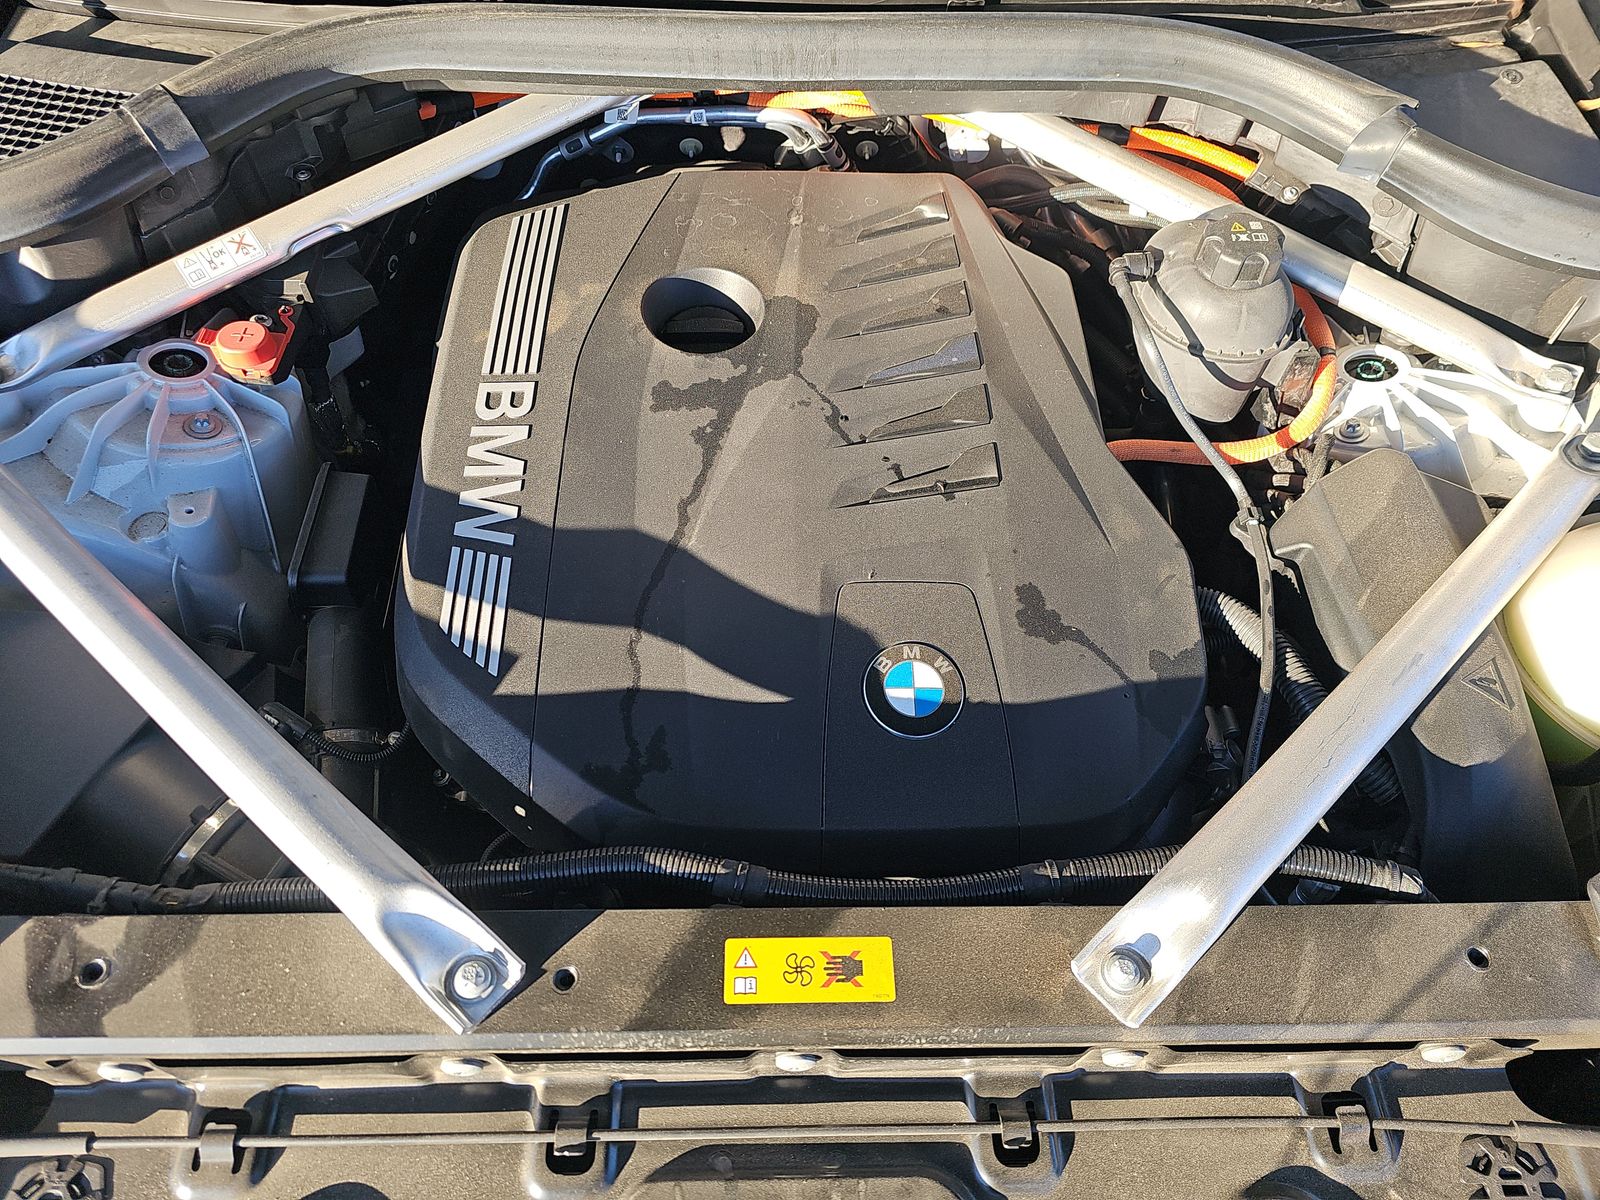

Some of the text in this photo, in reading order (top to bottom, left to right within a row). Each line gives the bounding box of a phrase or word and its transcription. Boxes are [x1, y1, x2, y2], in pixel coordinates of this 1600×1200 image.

[212, 247, 227, 259] OK
[453, 380, 537, 547] BMW
[873, 645, 954, 675] BMW
